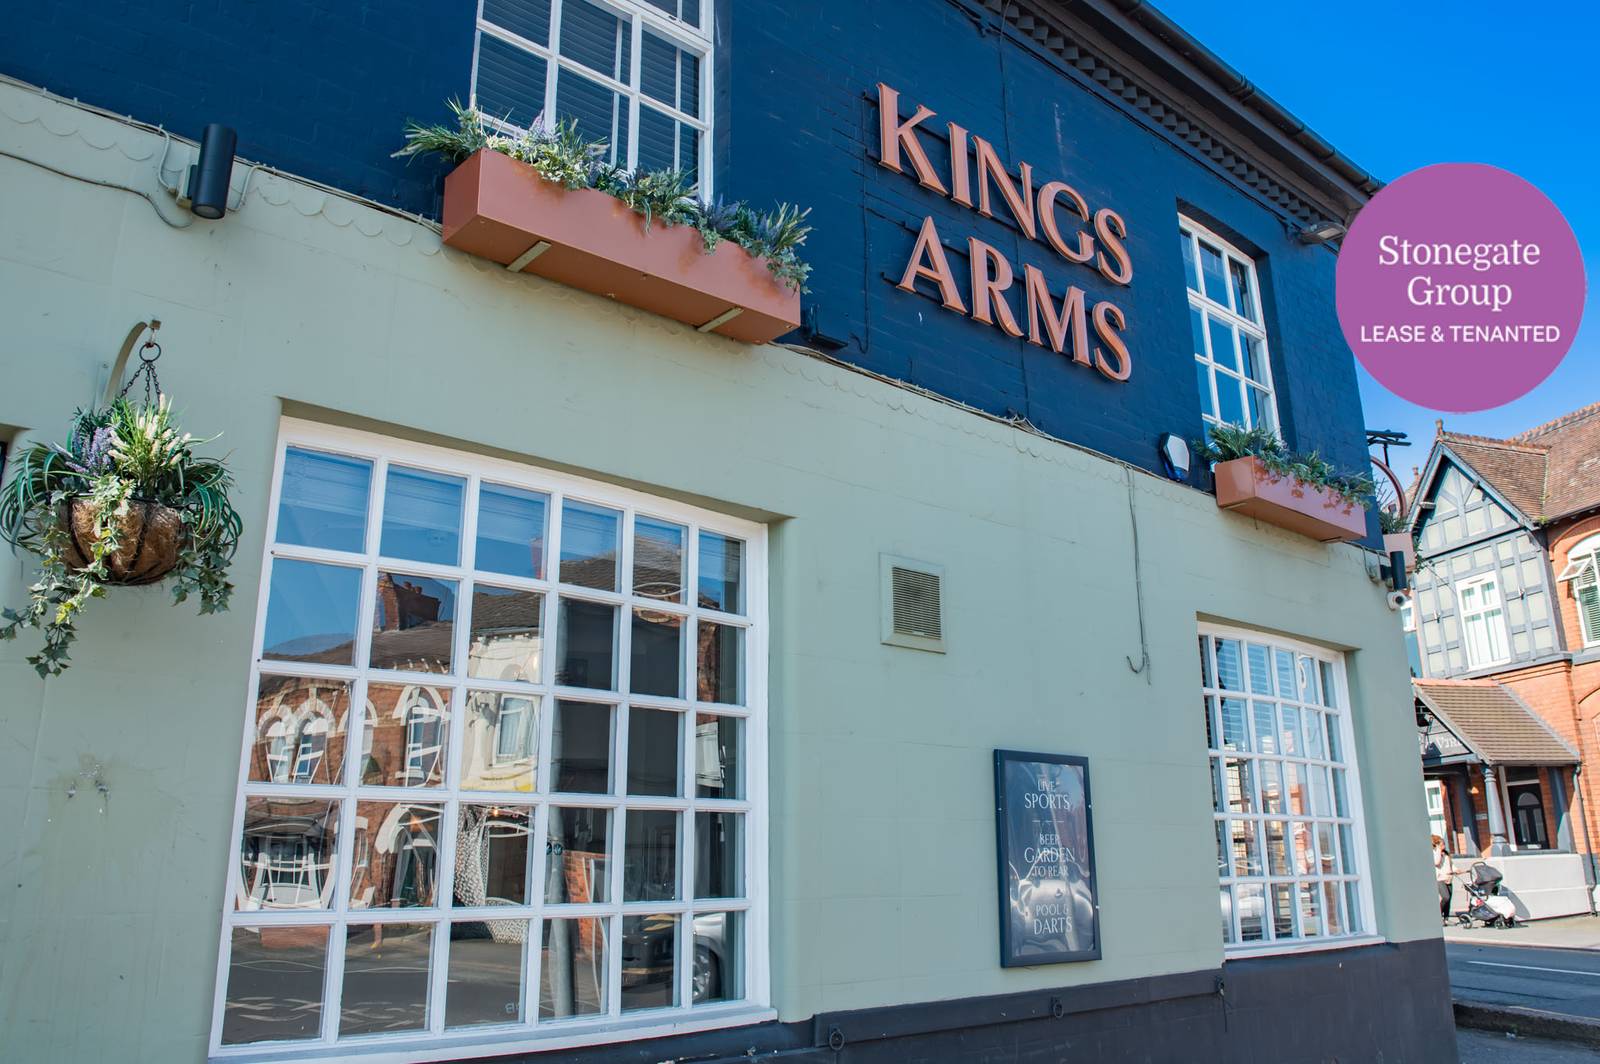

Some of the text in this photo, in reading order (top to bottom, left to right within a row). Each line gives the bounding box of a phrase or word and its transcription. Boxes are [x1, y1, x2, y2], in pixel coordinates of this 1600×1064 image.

[876, 82, 1133, 286] KINGS
[896, 216, 1132, 381] ARMS
[1038, 780, 1056, 792] LIVE
[1024, 792, 1070, 810] SPORTS
[1024, 847, 1075, 863] GARDEN
[1033, 865, 1069, 878] TO REAR
[1035, 904, 1060, 916] POOL
[1034, 916, 1073, 935] DARTS
